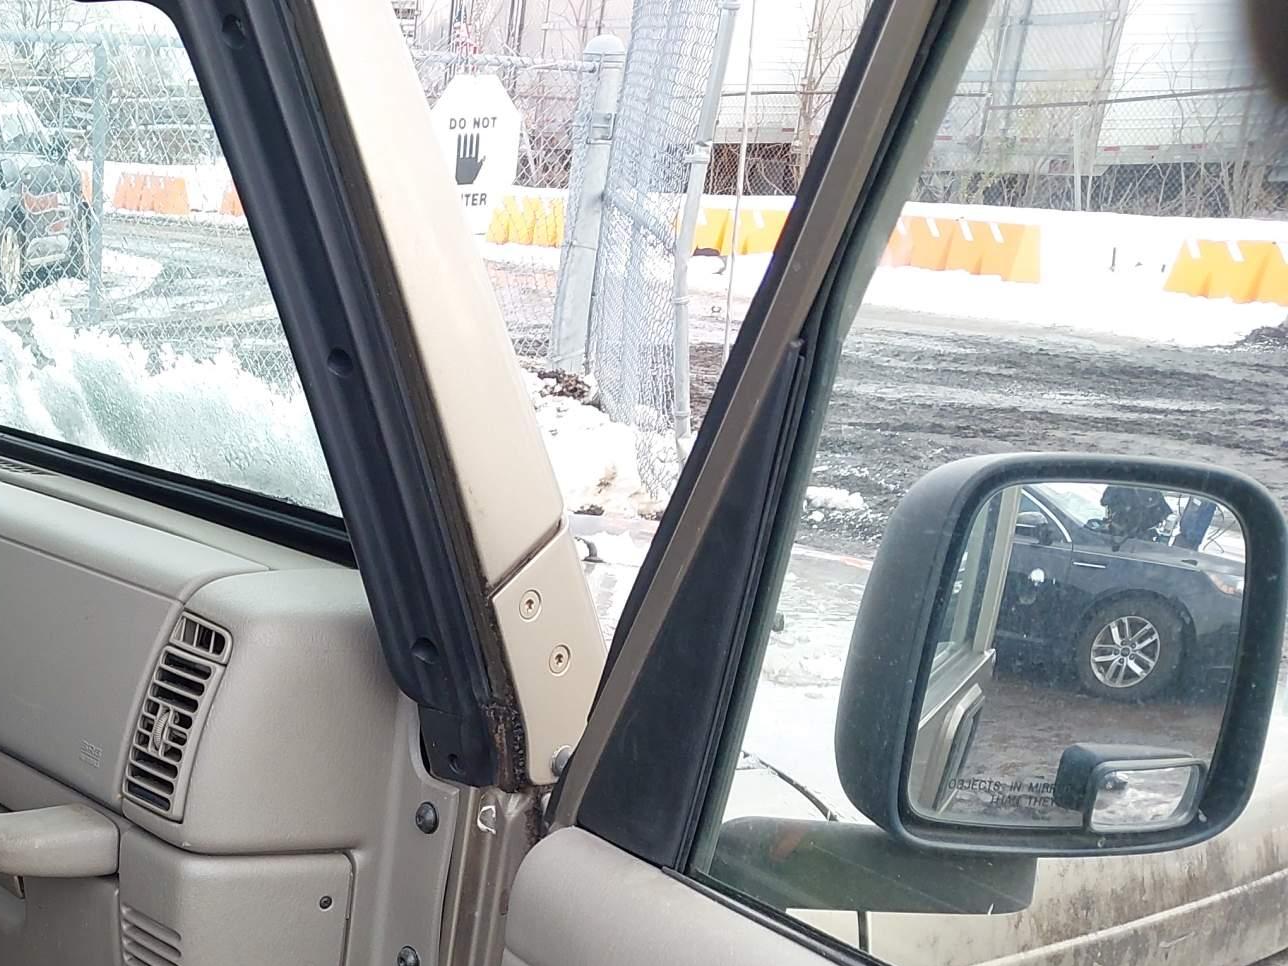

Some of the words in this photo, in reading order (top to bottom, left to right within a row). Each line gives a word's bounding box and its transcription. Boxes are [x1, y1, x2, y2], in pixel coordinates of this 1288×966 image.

[449, 117, 466, 130] DO
[473, 116, 497, 129] NOT
[461, 193, 487, 207] TER
[948, 779, 1001, 792] OBJECTS
[1009, 781, 1022, 792] IN
